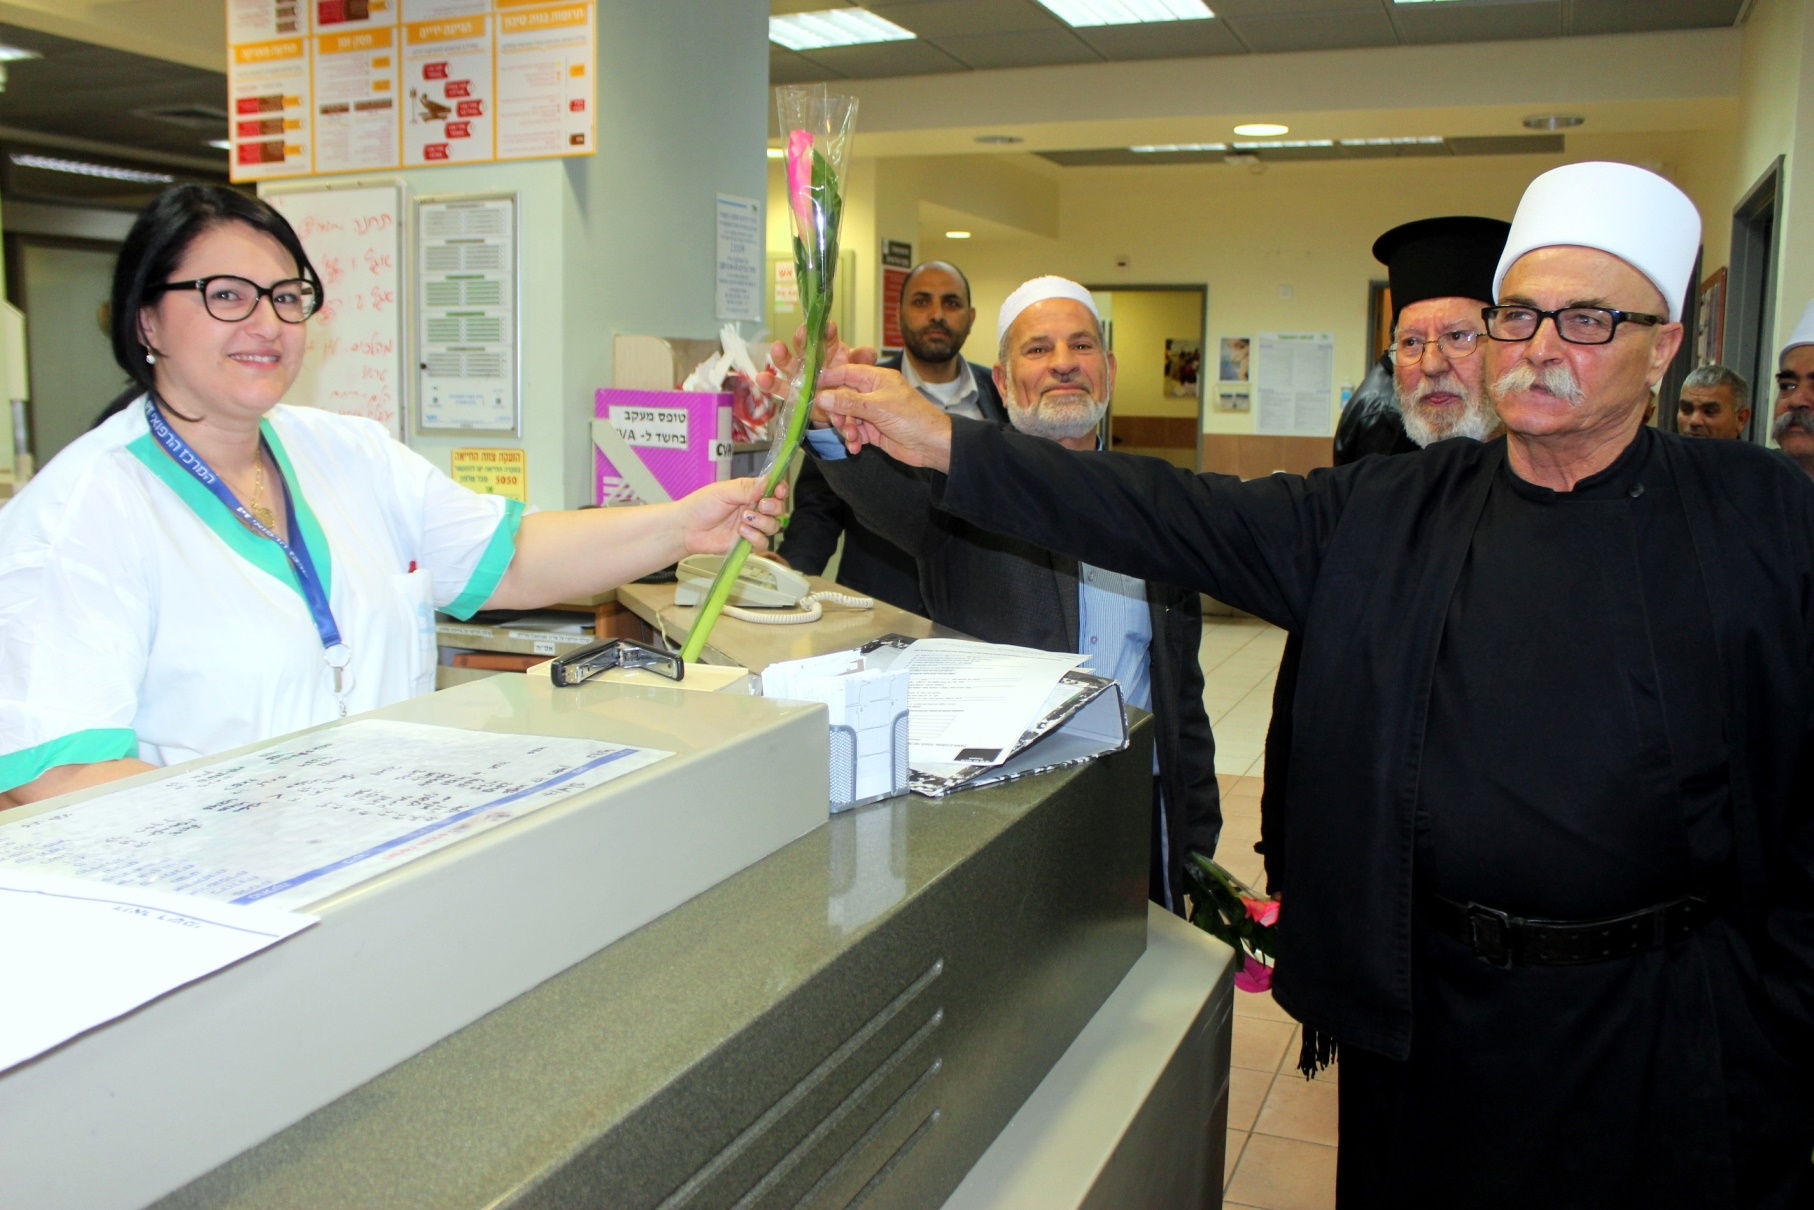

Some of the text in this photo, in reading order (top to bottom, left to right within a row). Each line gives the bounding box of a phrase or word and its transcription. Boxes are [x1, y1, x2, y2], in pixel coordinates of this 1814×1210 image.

[624, 410, 686, 424] טופס מעקב
[616, 428, 636, 441] VA
[656, 433, 686, 444] בחשד
[179, 448, 216, 485] המרכז
[496, 476, 518, 485] 5050
